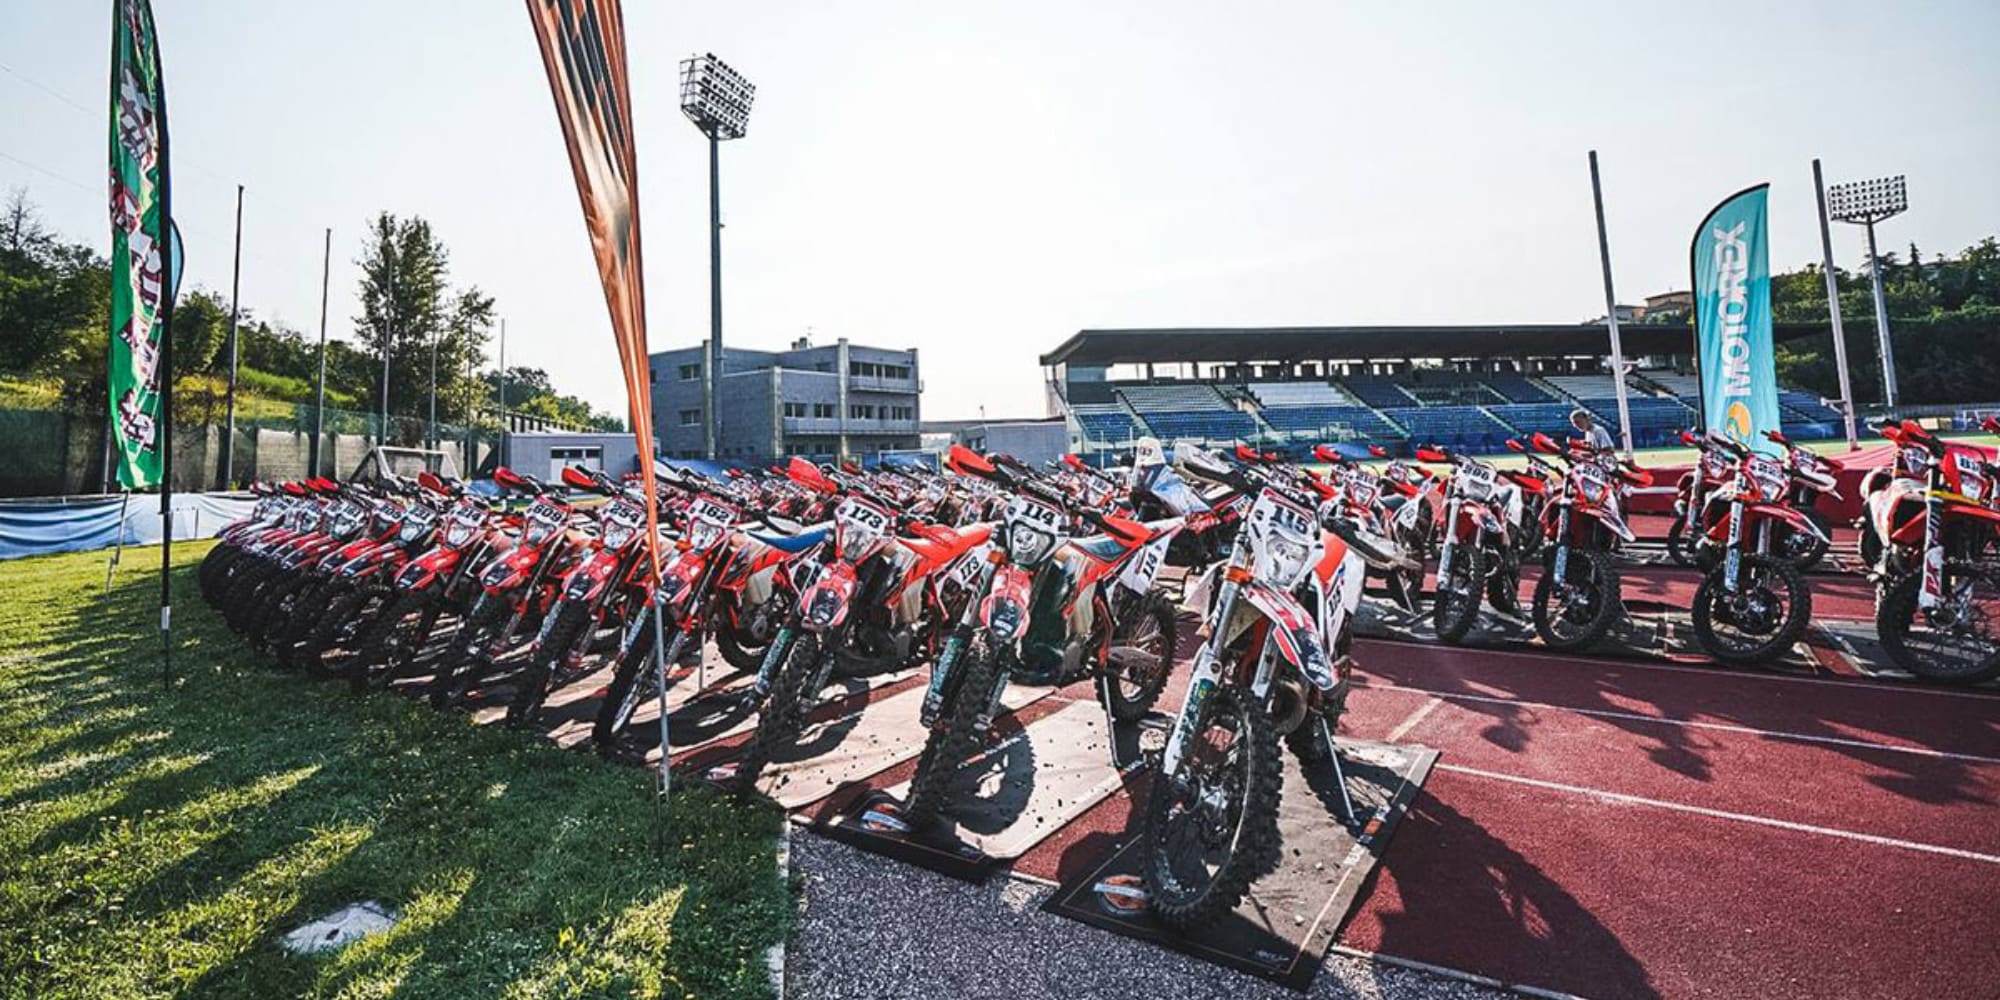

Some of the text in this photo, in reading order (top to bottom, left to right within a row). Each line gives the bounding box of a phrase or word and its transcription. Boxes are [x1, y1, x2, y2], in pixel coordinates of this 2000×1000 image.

[1713, 220, 1751, 397] MOTOREX
[533, 503, 562, 522] 609
[609, 503, 640, 523] 254
[700, 503, 730, 522] 162
[851, 506, 883, 529] 173
[1022, 503, 1055, 524] 114
[1270, 505, 1308, 535] 115
[959, 556, 981, 582] 173
